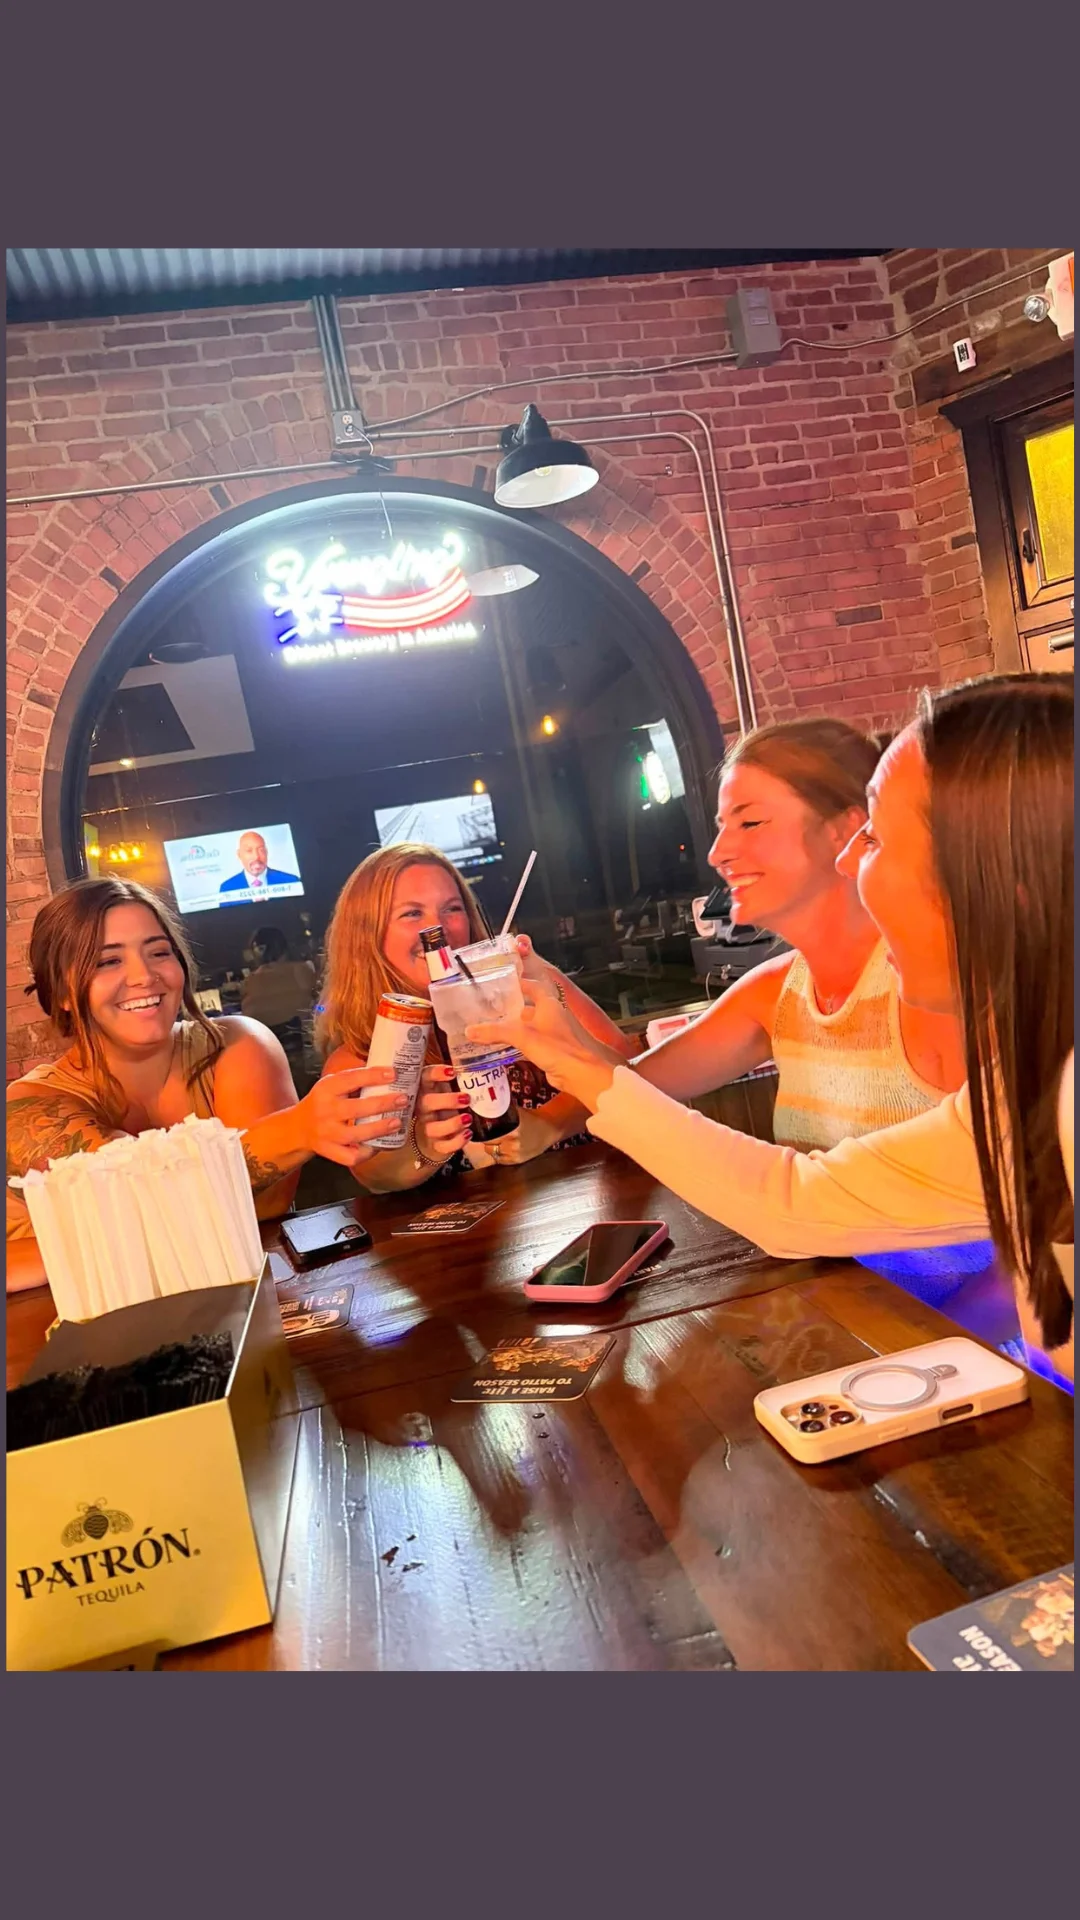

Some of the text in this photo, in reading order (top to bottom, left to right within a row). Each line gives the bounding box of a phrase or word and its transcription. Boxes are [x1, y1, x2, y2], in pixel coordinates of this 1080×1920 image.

[463, 1065, 505, 1090] ULTRA
[473, 1377, 573, 1387] TO PATIO SEASON
[511, 1386, 520, 1395] A
[521, 1386, 556, 1395] RAISE
[76, 1582, 146, 1607] TEQUILA
